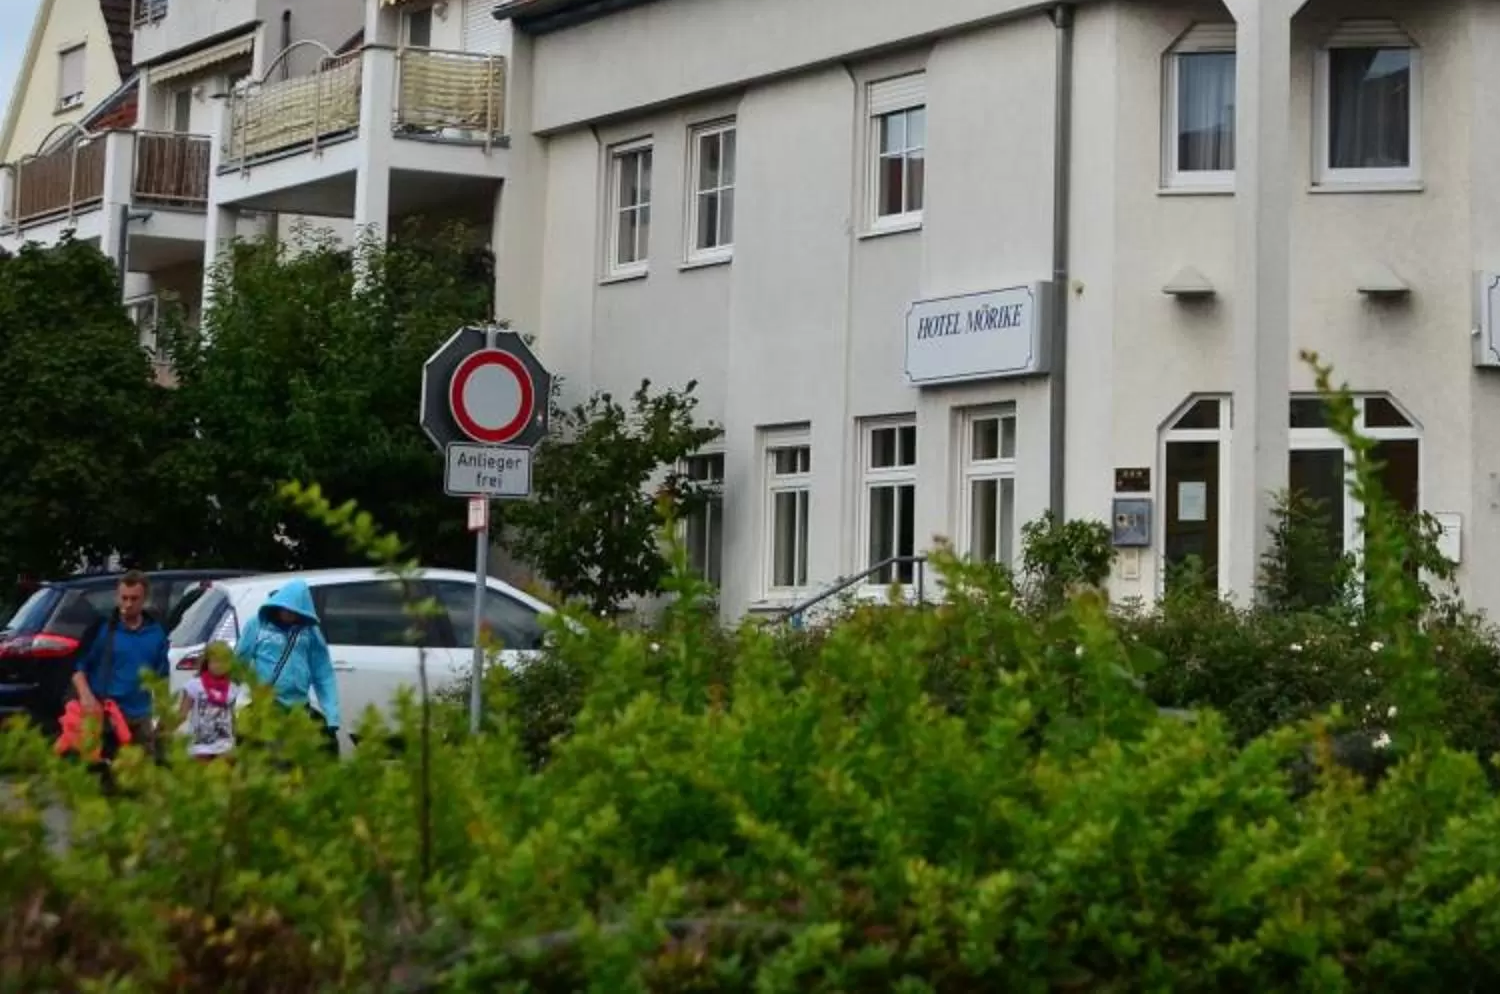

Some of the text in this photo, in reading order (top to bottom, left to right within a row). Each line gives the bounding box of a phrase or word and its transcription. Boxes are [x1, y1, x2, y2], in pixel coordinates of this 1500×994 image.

[917, 303, 1023, 339] HOTEL MÖRIKE
[457, 452, 522, 472] Anlieger
[476, 472, 502, 488] frei
